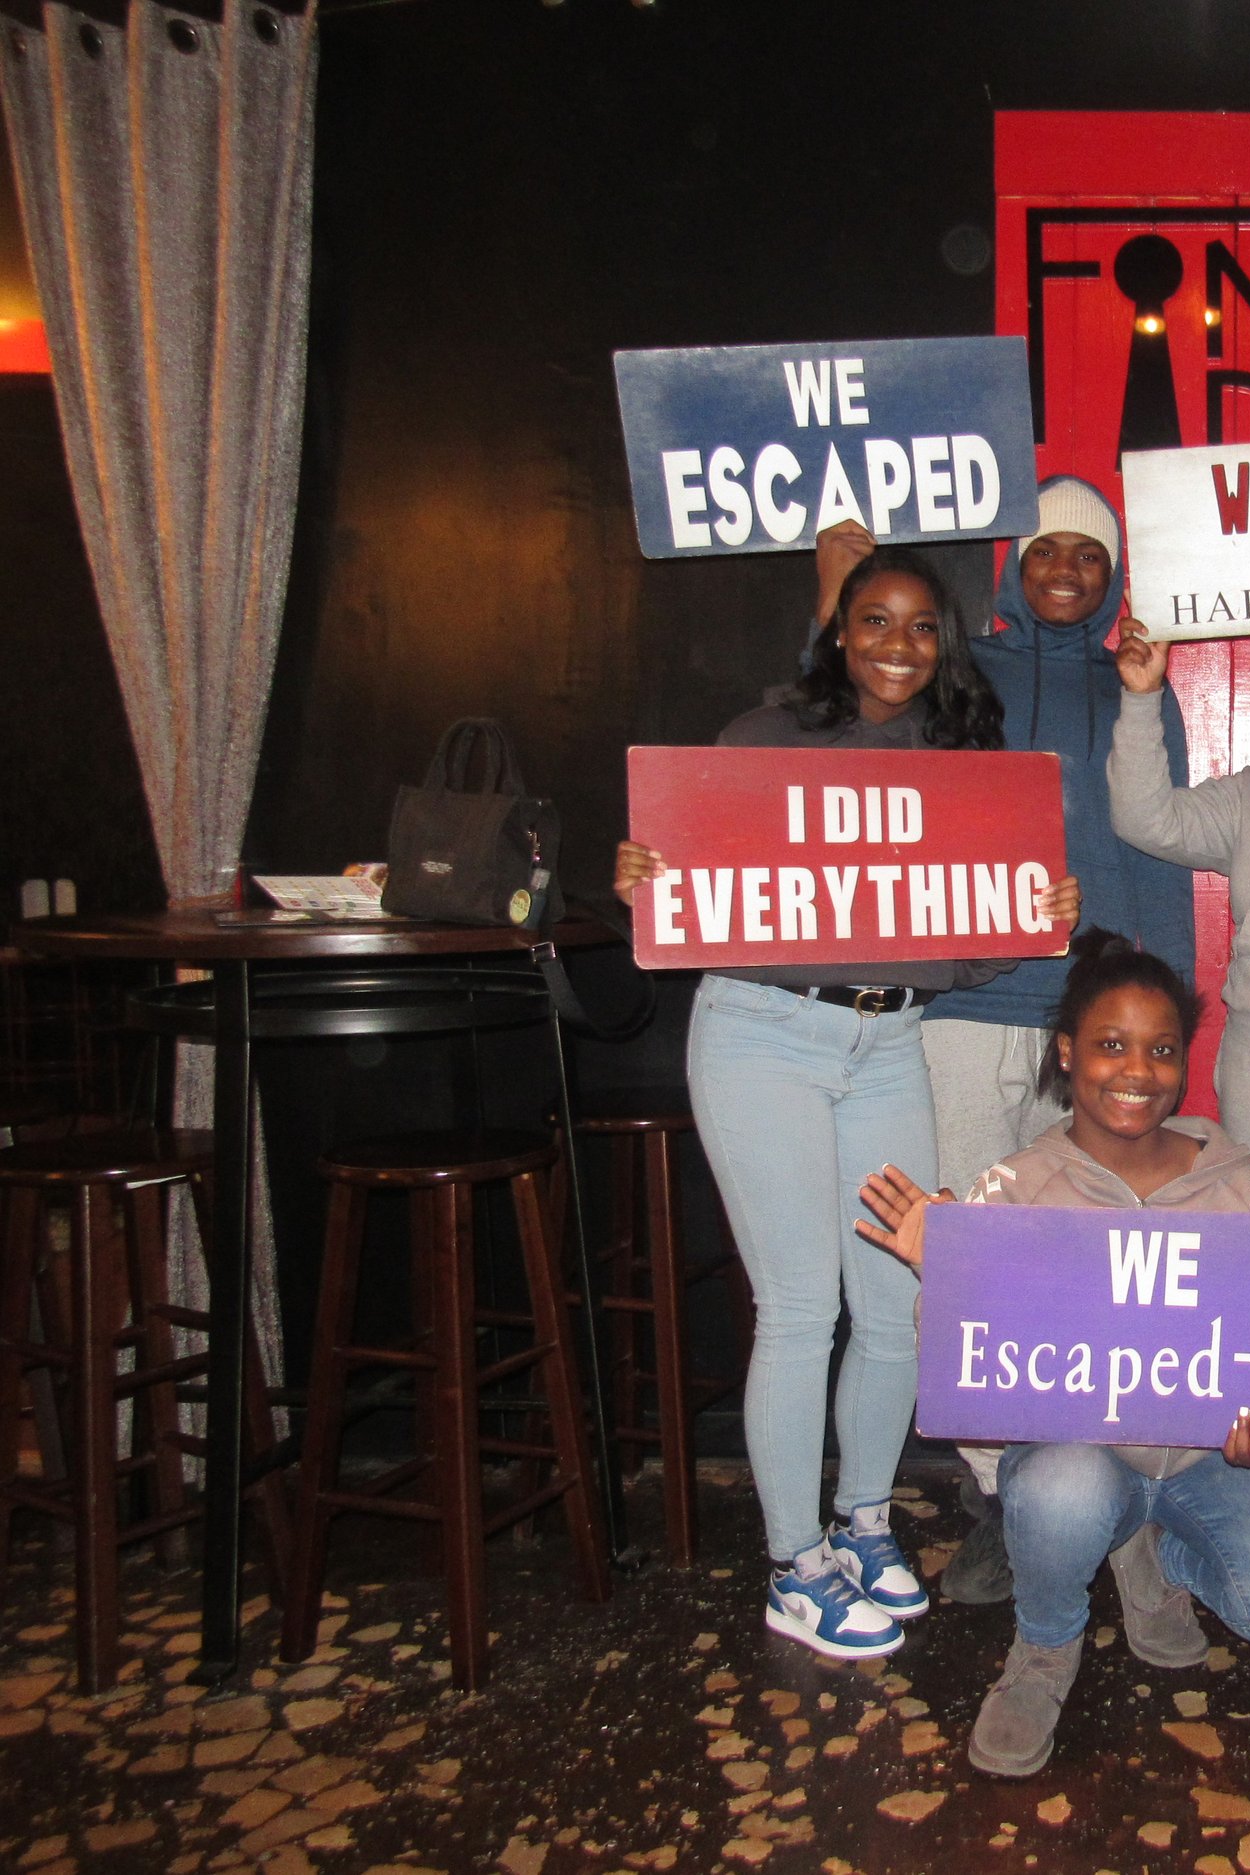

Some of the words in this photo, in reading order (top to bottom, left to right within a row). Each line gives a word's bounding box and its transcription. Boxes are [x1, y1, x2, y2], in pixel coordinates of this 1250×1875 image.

[783, 358, 870, 428] WE
[661, 434, 1001, 550] ESCAPED
[787, 785, 806, 843] I
[823, 785, 924, 844] DID
[653, 861, 1054, 946] EVERYTHING
[1108, 1229, 1201, 1307] WE
